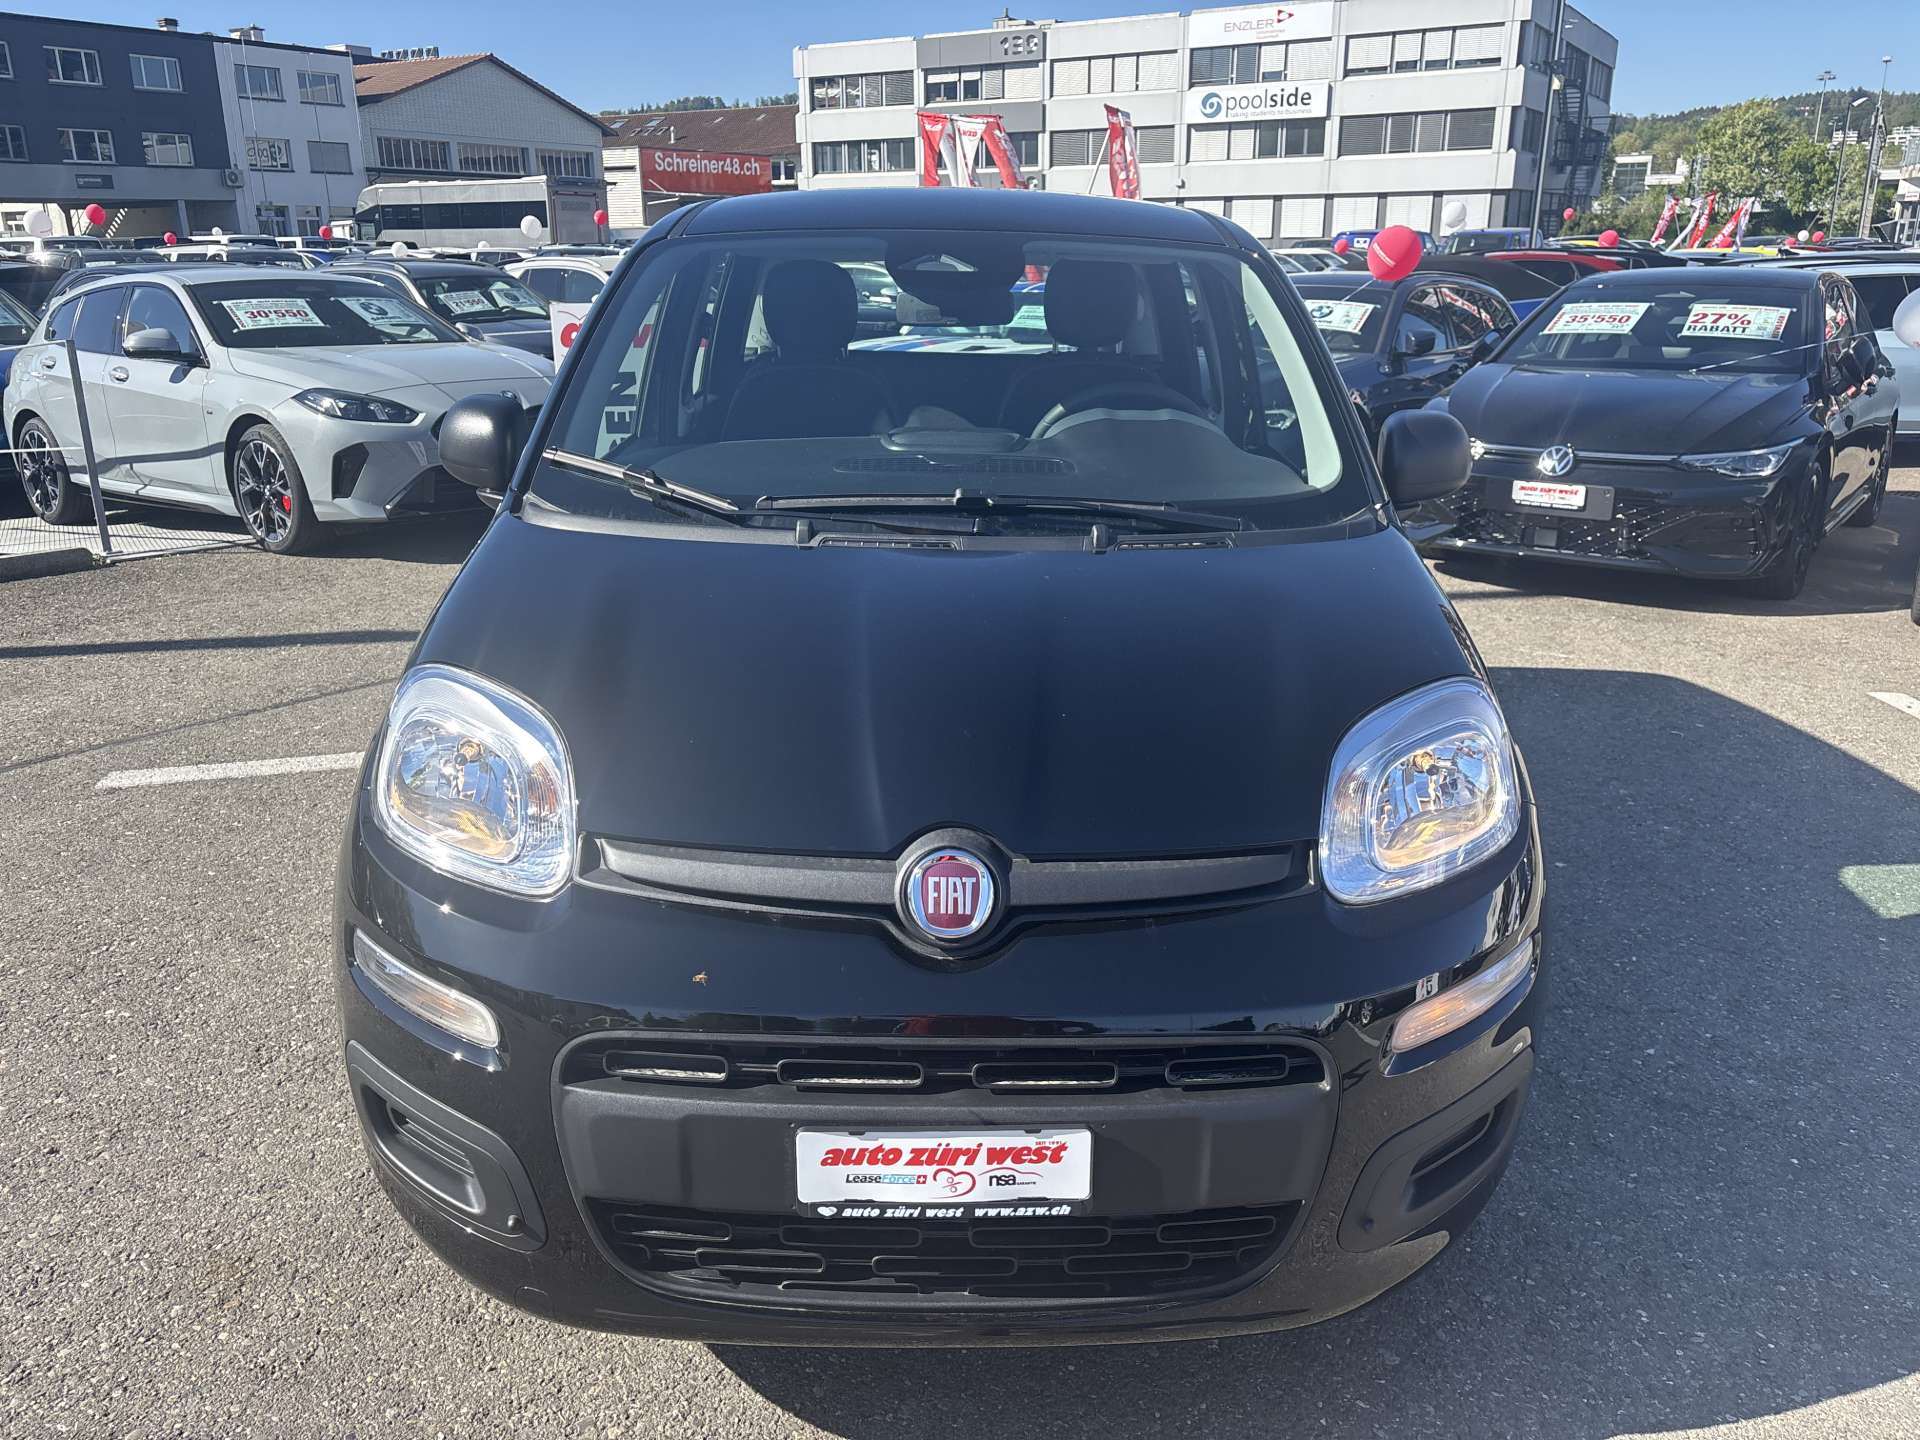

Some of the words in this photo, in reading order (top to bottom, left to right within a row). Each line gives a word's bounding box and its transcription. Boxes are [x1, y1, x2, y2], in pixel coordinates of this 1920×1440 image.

[1224, 19, 1274, 32] ENZLER
[1000, 34, 1038, 55] 139
[1226, 86, 1312, 117] poolside
[655, 152, 760, 176] Schreiner48.ch
[244, 309, 309, 319] 30'550
[1566, 314, 1631, 324] 35'550
[1690, 313, 1752, 326] 27%
[1686, 325, 1750, 334] RABATT
[927, 876, 977, 915] FIAT
[820, 1143, 903, 1166] auto
[904, 1142, 983, 1166] züri
[986, 1142, 1069, 1165] west
[845, 1173, 917, 1184] LeaseForce
[989, 1174, 1016, 1187] nsa
[842, 1206, 881, 1217] auto
[884, 1205, 922, 1217] züri
[925, 1206, 964, 1217] west
[974, 1204, 1071, 1217] www.azw.ch
